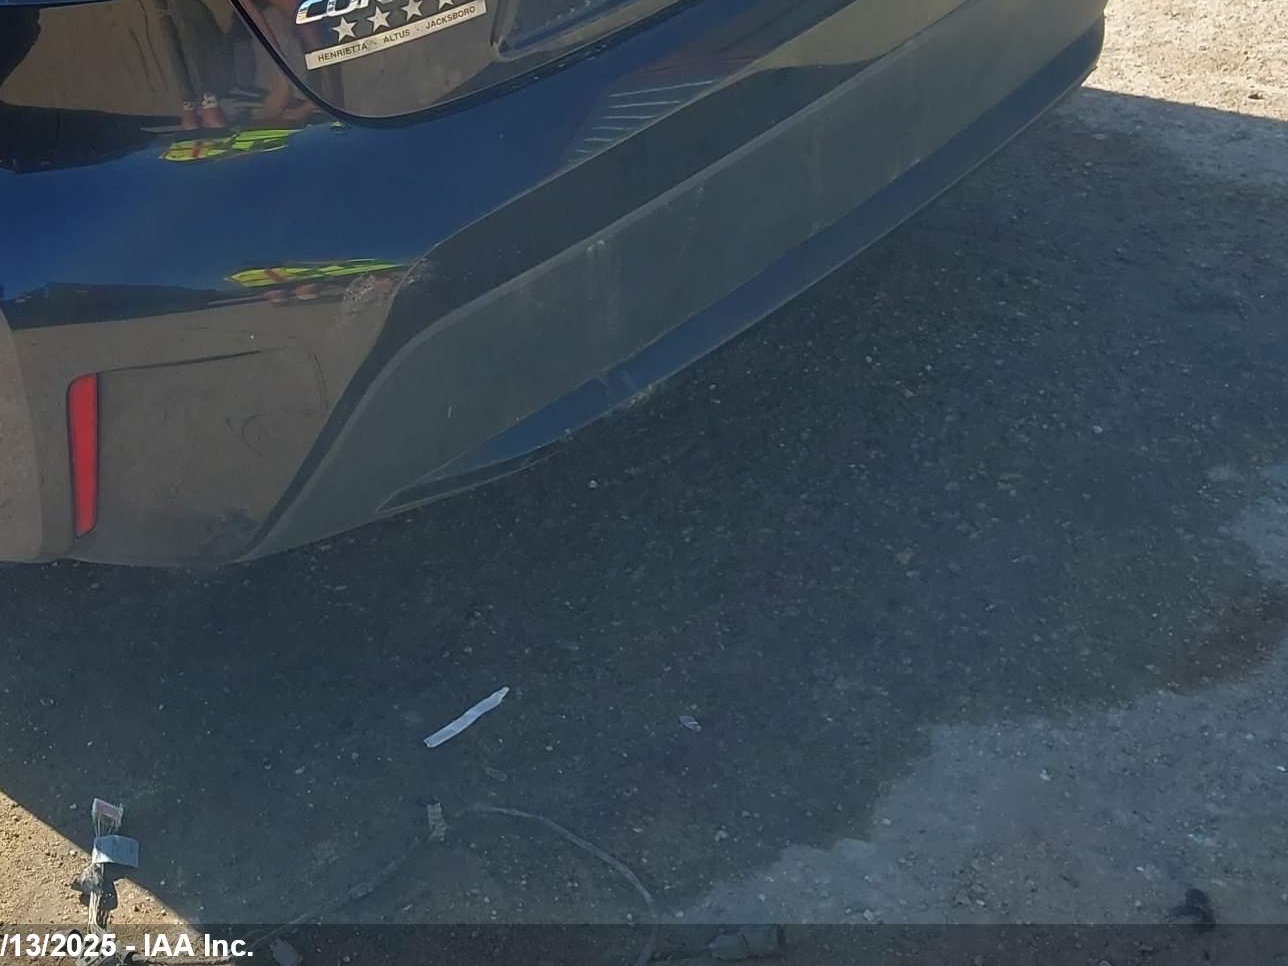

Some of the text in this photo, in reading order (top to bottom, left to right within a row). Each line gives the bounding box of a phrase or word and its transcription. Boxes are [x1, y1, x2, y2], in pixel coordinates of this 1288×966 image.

[317, 5, 476, 62] HENRIETTA ALTUS JACKSBORO
